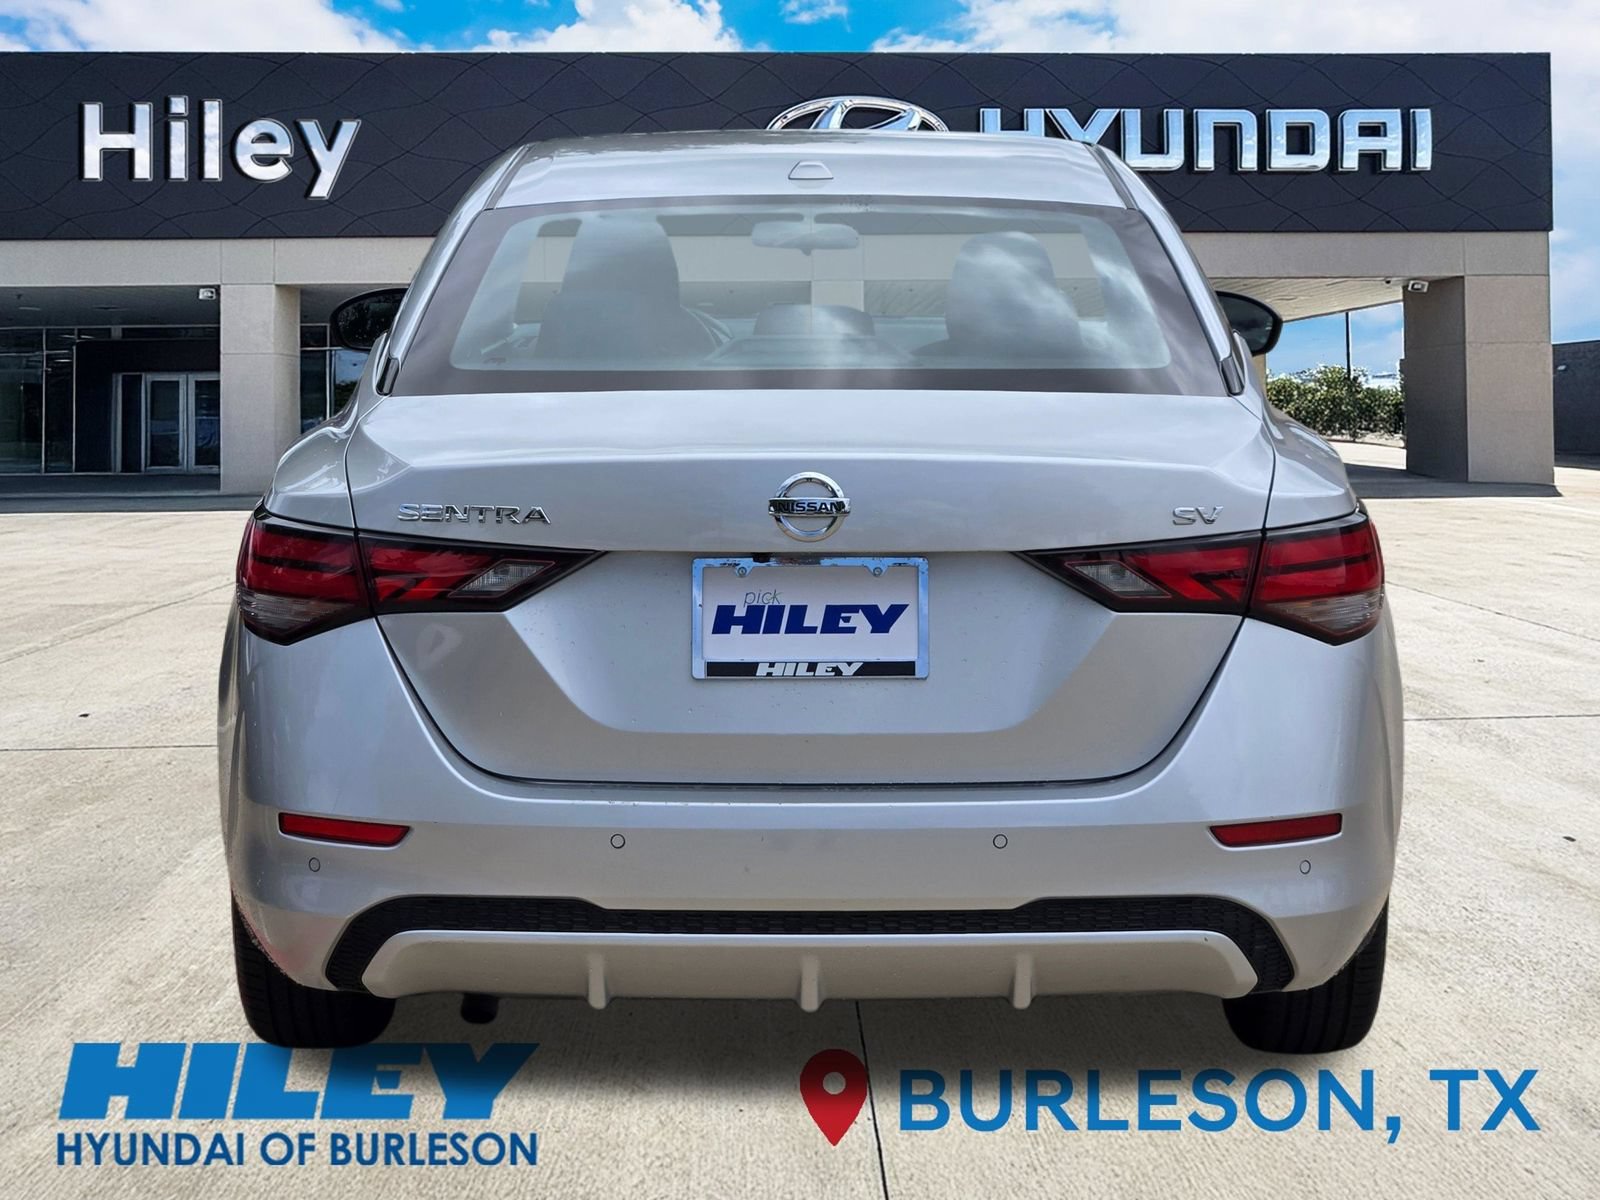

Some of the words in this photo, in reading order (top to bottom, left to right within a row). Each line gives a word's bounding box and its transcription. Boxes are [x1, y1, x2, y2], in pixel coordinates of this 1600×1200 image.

[79, 95, 361, 200] Hiley
[397, 503, 551, 524] SENTRA
[779, 501, 844, 513] NISSAN
[1172, 506, 1223, 526] SV
[743, 589, 782, 607] pick
[711, 604, 909, 634] HILEY
[755, 662, 863, 677] HILEY
